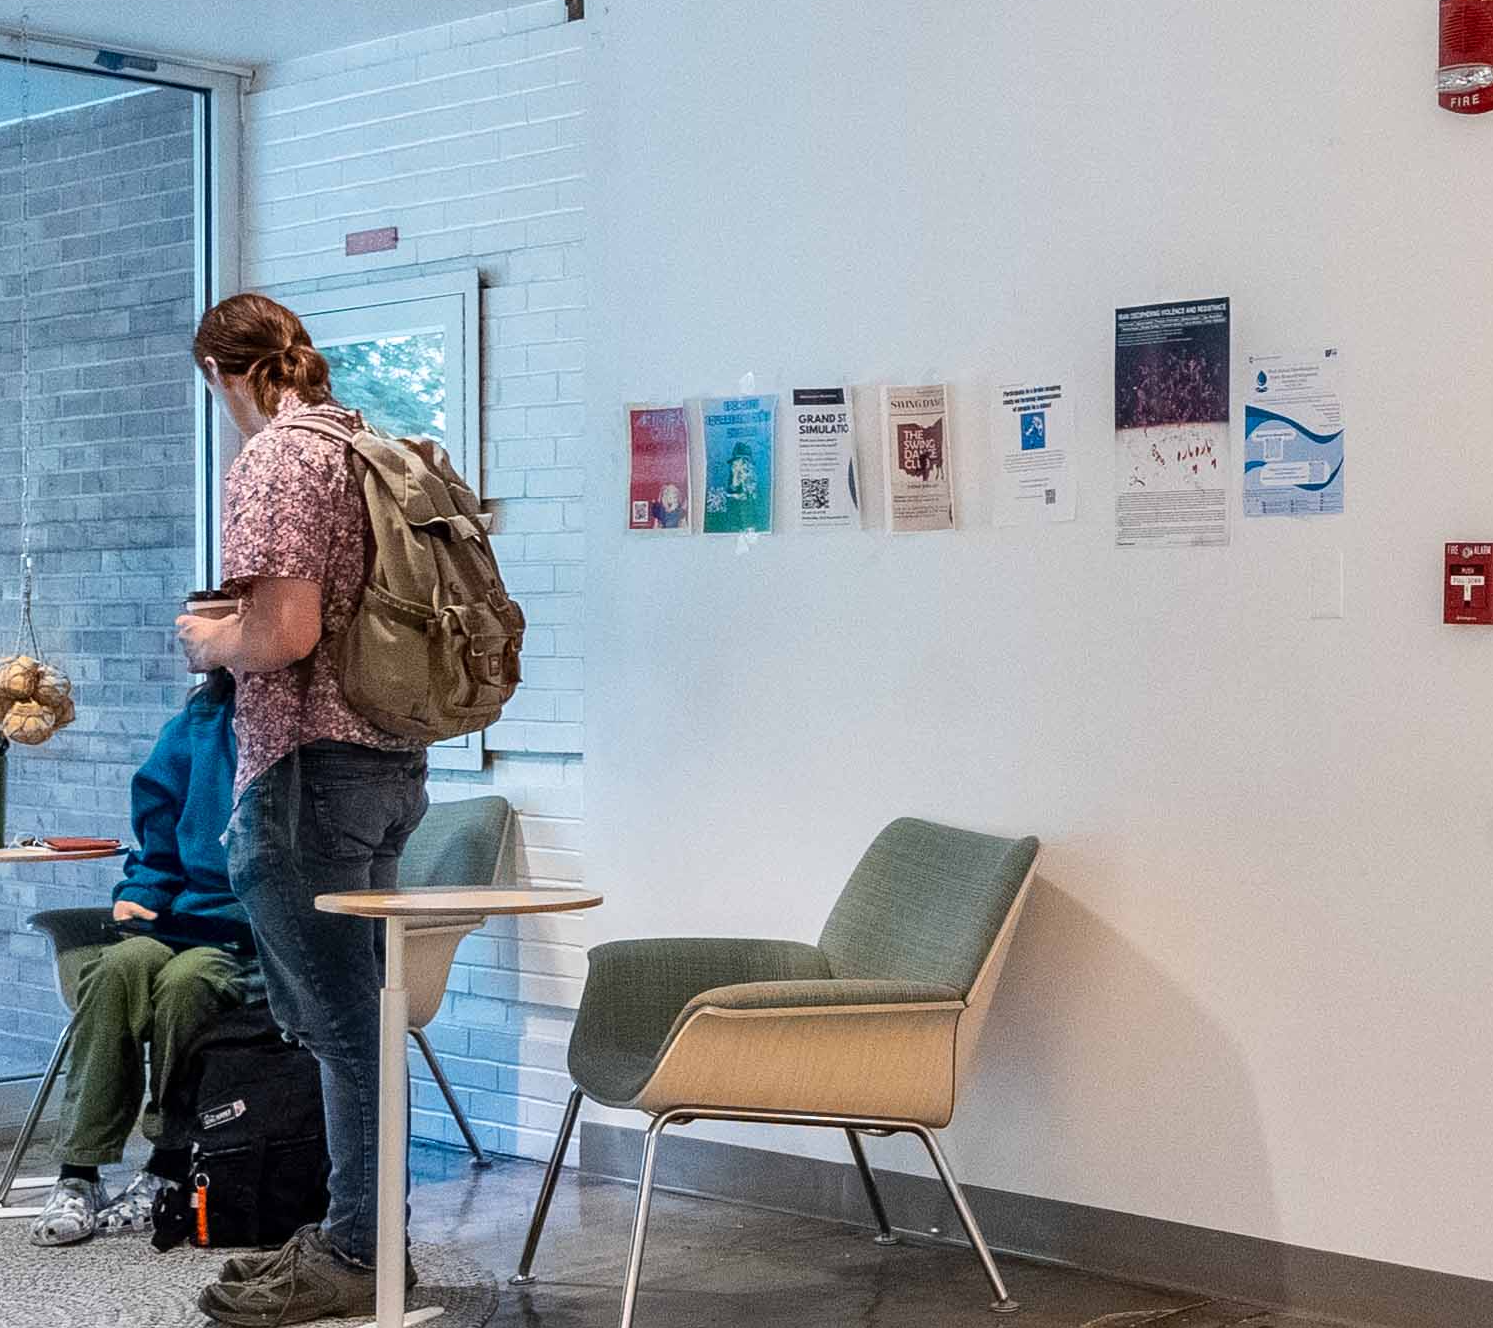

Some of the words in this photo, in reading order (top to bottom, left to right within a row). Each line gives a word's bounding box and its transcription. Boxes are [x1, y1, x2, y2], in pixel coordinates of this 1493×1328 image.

[1450, 94, 1480, 108] FIRE
[798, 413, 836, 425] GRAND
[799, 423, 849, 435] SIMULATIO
[903, 430, 924, 440] THE
[903, 439, 935, 450] SWING
[904, 458, 931, 470] CL
[1474, 544, 1492, 555] ALARM
